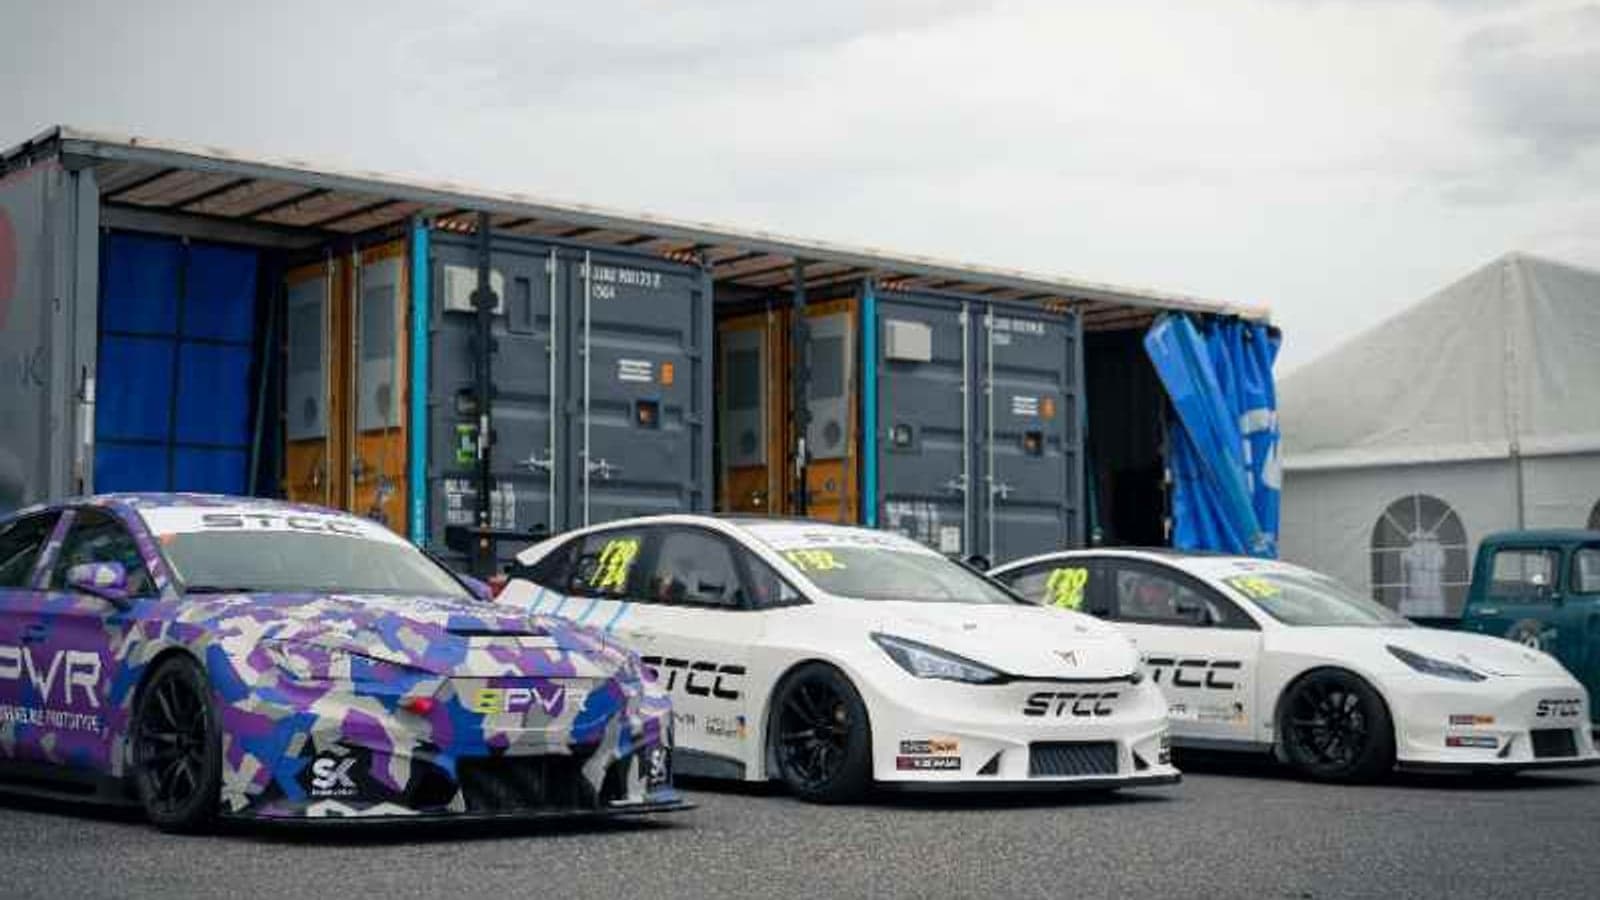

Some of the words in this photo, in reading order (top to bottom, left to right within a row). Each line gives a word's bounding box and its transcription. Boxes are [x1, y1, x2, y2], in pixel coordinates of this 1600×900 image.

[202, 514, 366, 537] STCC
[1141, 658, 1241, 689] TCC
[1023, 692, 1119, 716] STCC
[1536, 699, 1581, 717] STCC
[312, 758, 357, 788] SK
